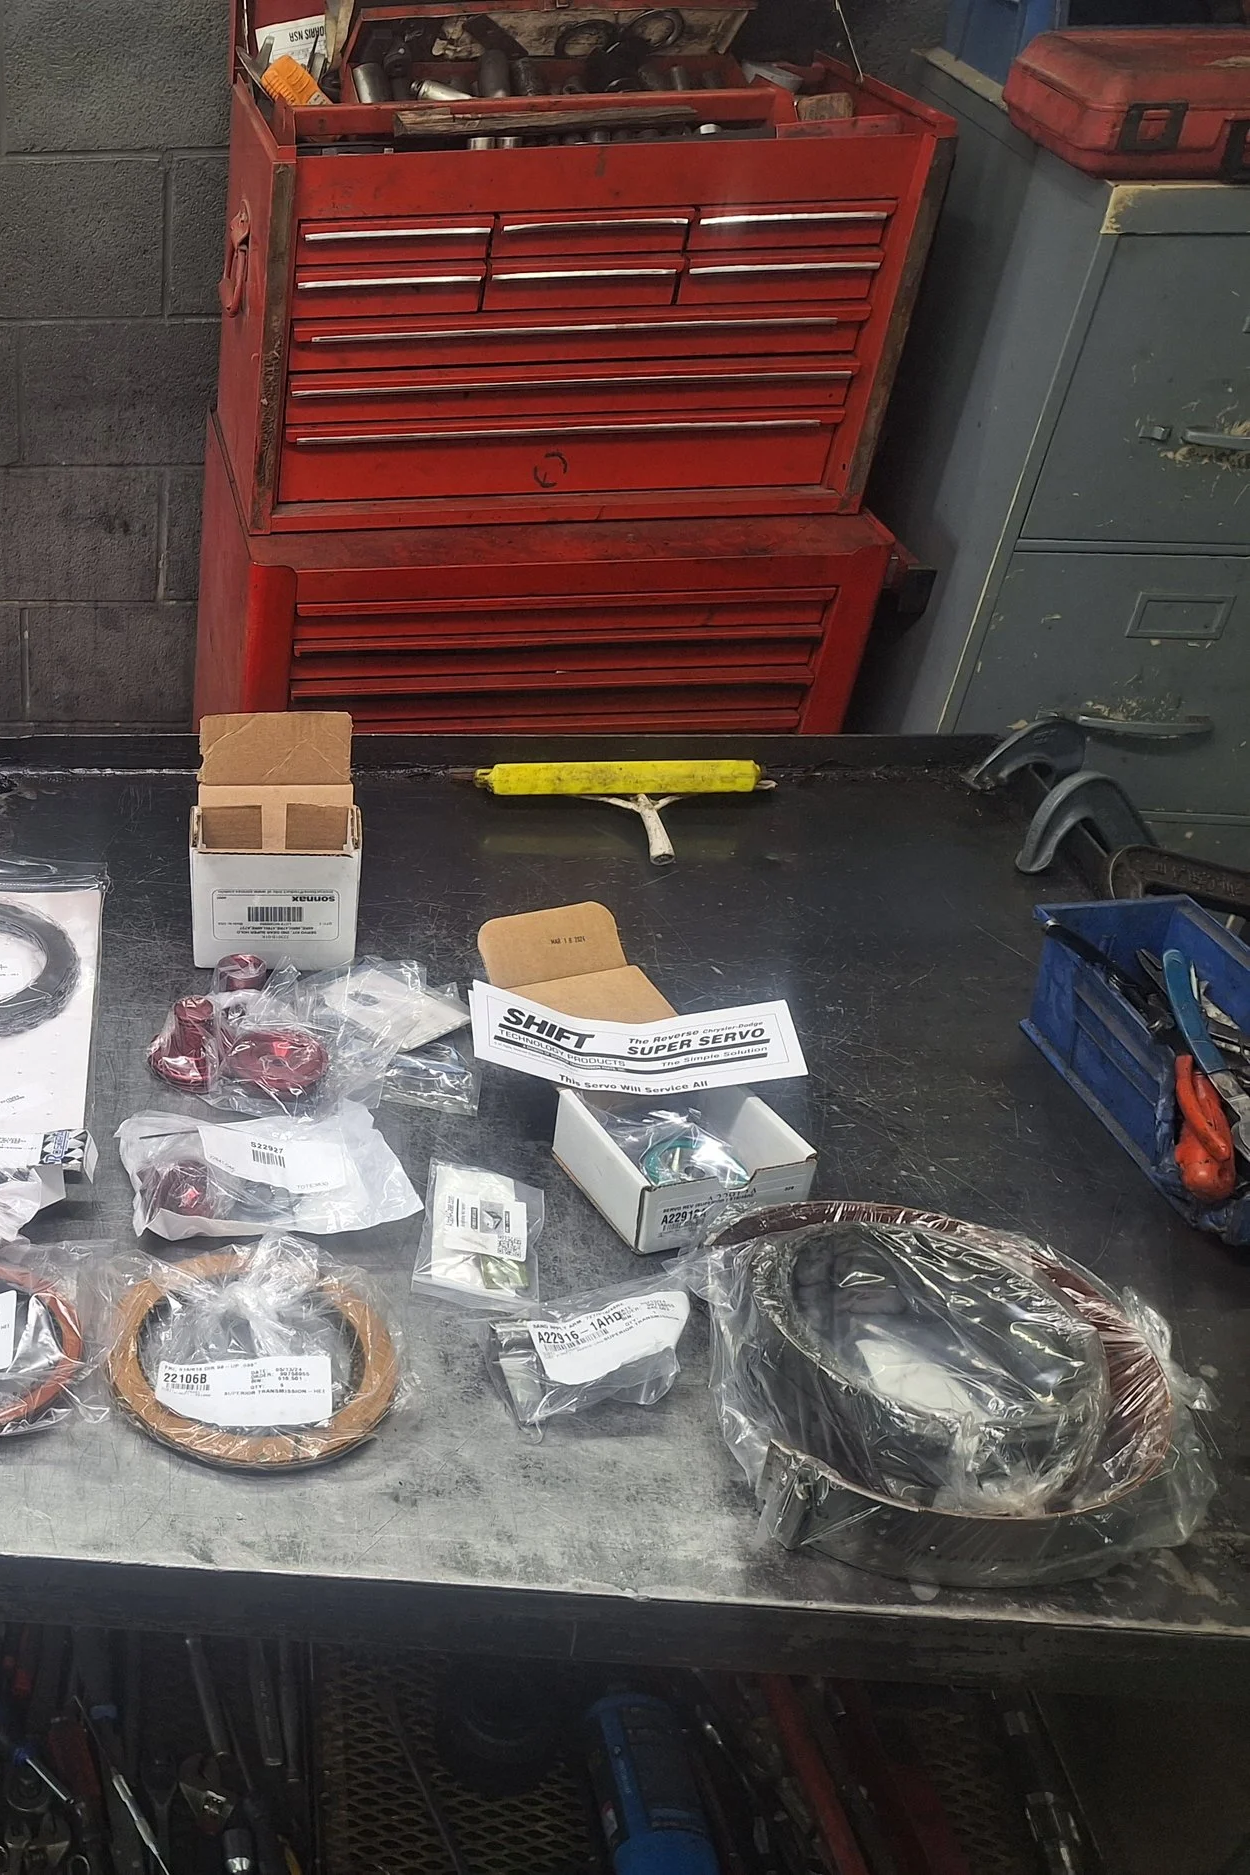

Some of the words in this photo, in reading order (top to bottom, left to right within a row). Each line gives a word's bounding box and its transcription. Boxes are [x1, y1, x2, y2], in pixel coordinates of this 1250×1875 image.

[503, 1008, 595, 1049] SHIFT
[653, 1030, 699, 1044] Reverse
[703, 1021, 763, 1034] Chrysler-Dodge
[498, 1029, 565, 1056] TECHNOLOGY
[567, 1054, 626, 1067] PRODUCTS
[627, 1039, 694, 1056] SUPER
[698, 1027, 765, 1046] SERVO
[684, 1053, 720, 1063] Simple
[723, 1046, 768, 1057] Solution
[558, 1073, 581, 1086] This
[584, 1082, 617, 1090] Servo
[620, 1084, 641, 1093] Will
[644, 1084, 689, 1093] Service
[692, 1080, 708, 1088] All
[250, 1141, 284, 1154] S22927
[163, 1373, 207, 1384] 22106B
